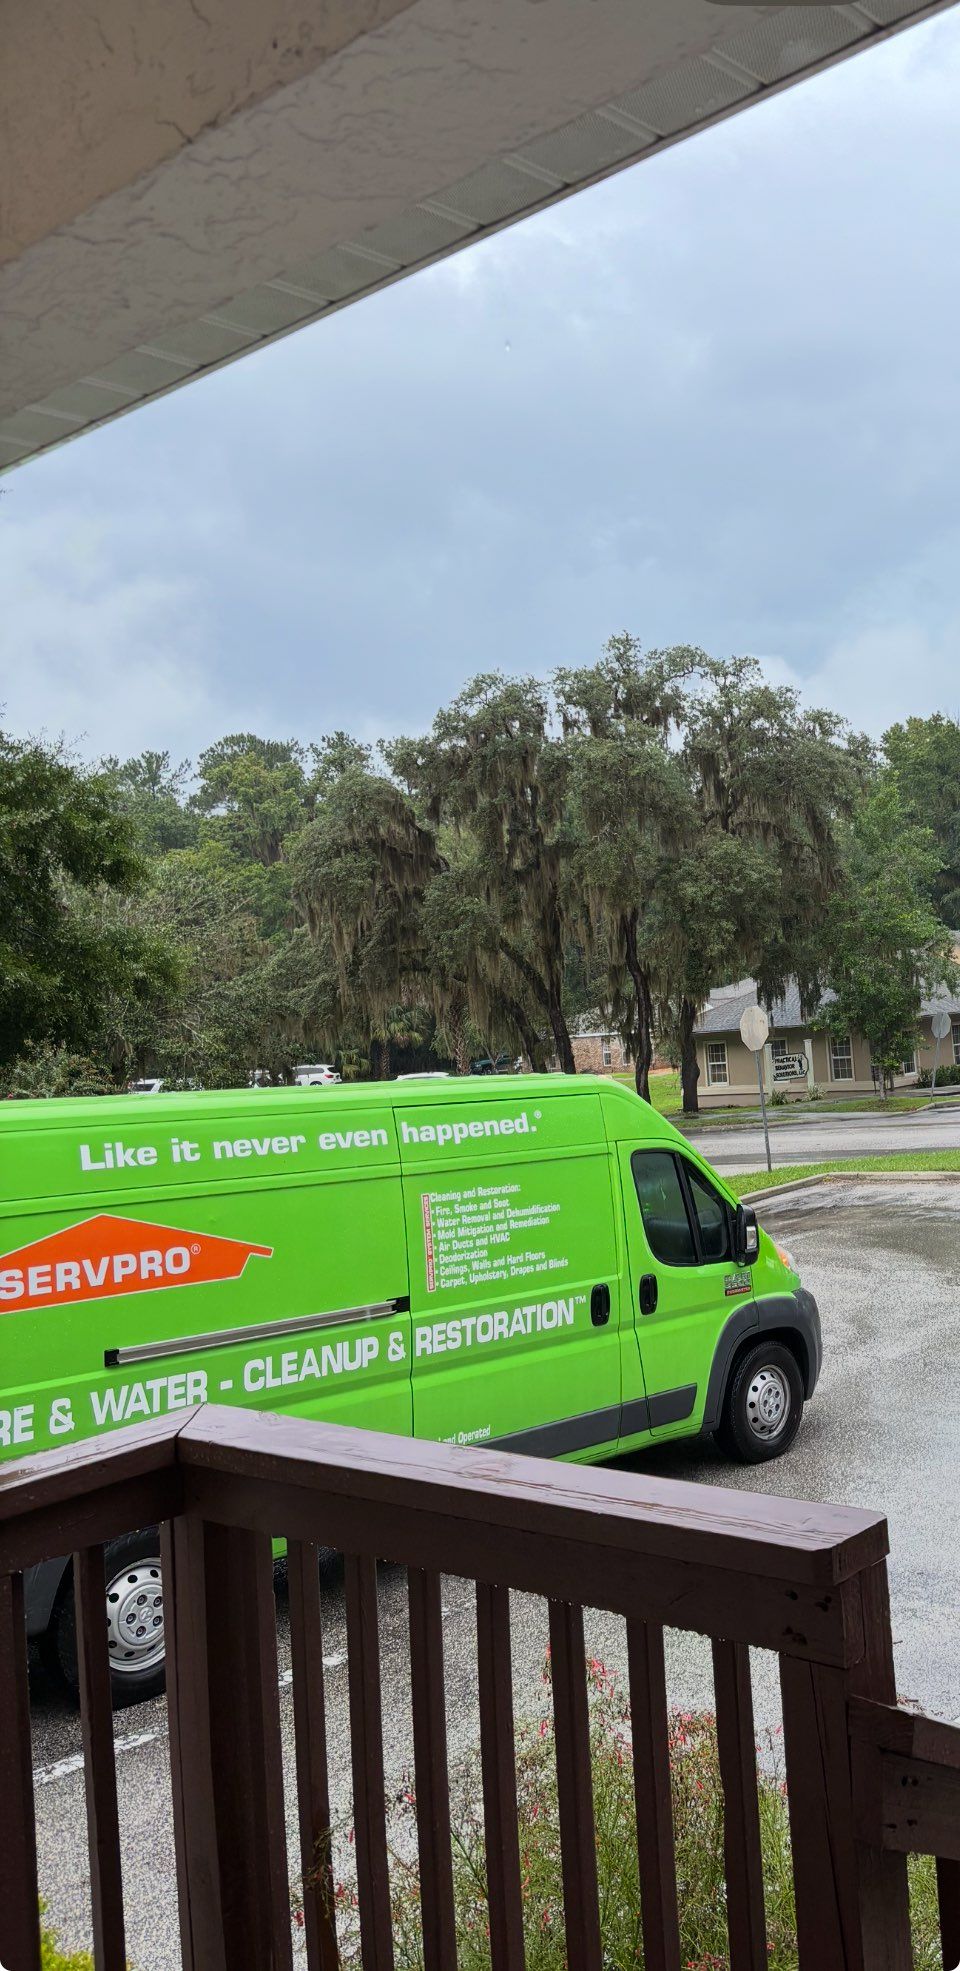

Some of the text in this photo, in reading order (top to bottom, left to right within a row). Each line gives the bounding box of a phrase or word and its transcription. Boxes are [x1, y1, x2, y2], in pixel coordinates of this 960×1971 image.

[80, 1142, 158, 1171] Like
[171, 1138, 201, 1163] it
[213, 1134, 306, 1159] never
[318, 1128, 388, 1150] even
[430, 1183, 521, 1202] Cleaning and Restoration:
[435, 1198, 510, 1216] Fire, Smoke and Soot
[437, 1203, 560, 1228] Water Removal and Dehumidification
[437, 1215, 550, 1239] Mold Mitigation and Remediation
[439, 1232, 511, 1252] Air Ducts and HVAC
[439, 1248, 488, 1265] Deodorization
[440, 1252, 545, 1276] Ceilings, Walls and Hard Floors
[440, 1257, 569, 1288] Carpet, Upholstery, Drapes and Blinds
[50, 1398, 75, 1435] &
[90, 1370, 208, 1425] WATER
[243, 1336, 379, 1392] CLEANUP
[387, 1331, 406, 1362] &
[458, 1424, 491, 1444] Operated
